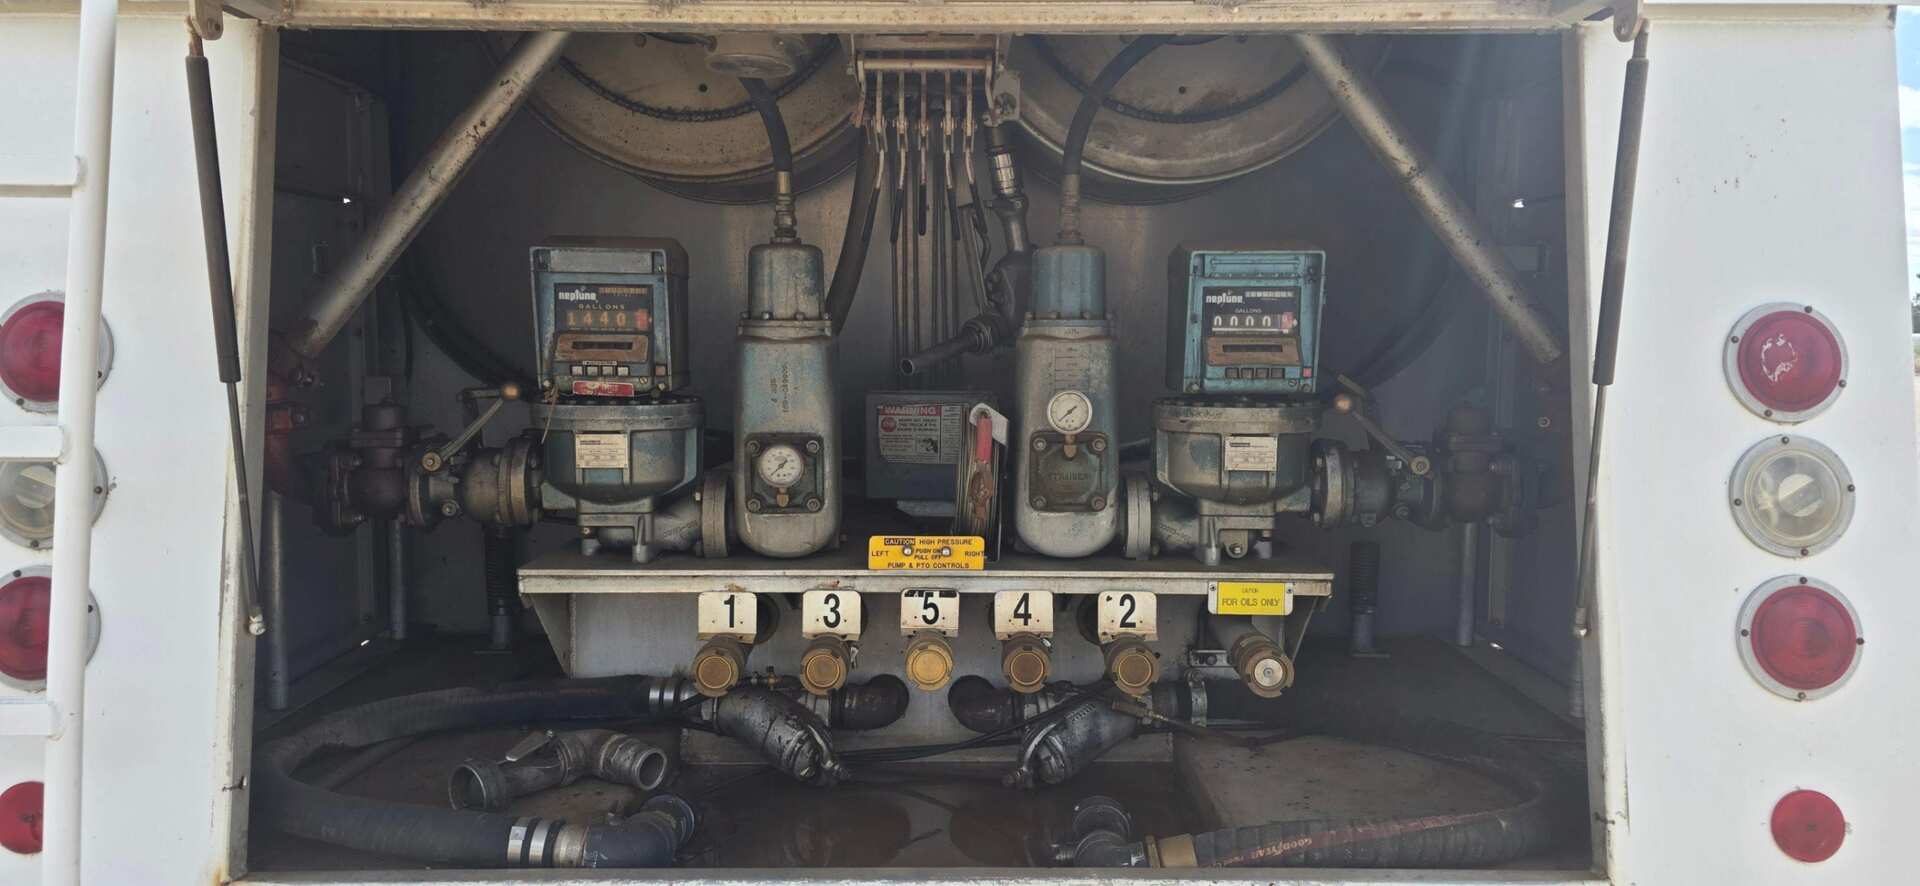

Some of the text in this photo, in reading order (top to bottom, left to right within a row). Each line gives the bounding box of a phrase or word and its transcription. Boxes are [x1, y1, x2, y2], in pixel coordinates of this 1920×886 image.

[558, 288, 597, 301] neptune
[1206, 292, 1243, 304] neptune
[884, 406, 936, 416] WARNING
[723, 595, 735, 628] 1
[823, 593, 841, 628] 3
[921, 592, 940, 625] 5
[1013, 593, 1032, 626] 4
[1119, 594, 1137, 628] 2
[1222, 597, 1280, 607] FOR OILS ONLY
